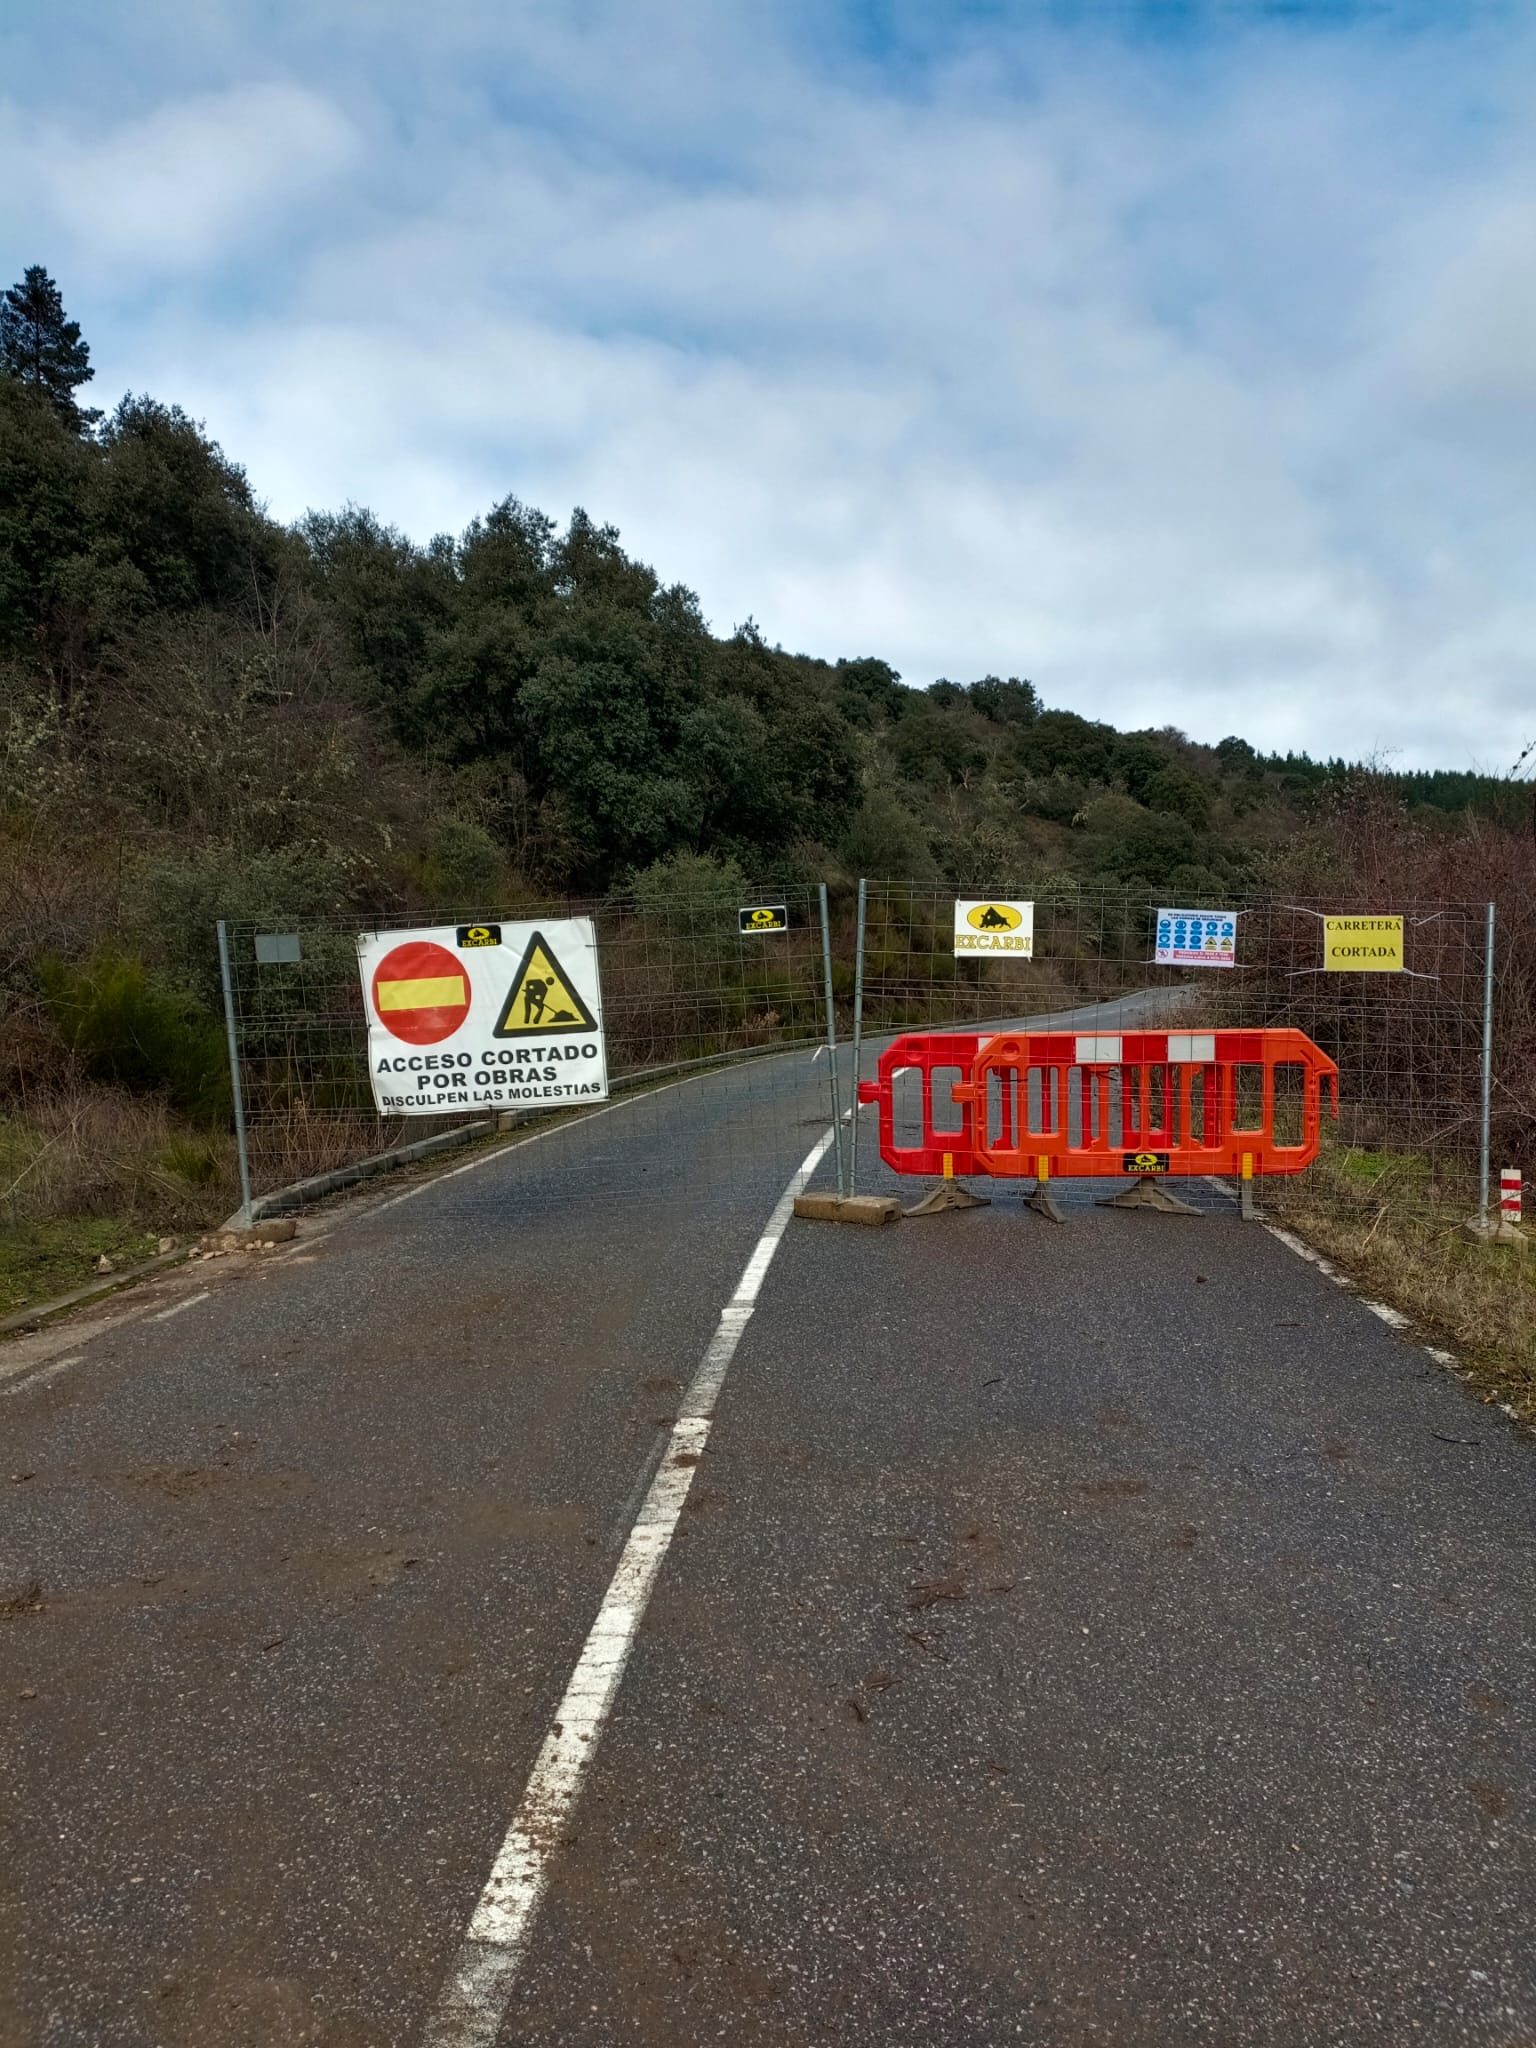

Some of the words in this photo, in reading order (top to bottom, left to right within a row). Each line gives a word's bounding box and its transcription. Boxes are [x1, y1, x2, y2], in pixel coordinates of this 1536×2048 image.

[1326, 920, 1401, 931] CARRETERA
[955, 934, 1031, 951] EXCARBI
[1331, 946, 1396, 957] CORTADA
[377, 1052, 472, 1073] ACCESO
[481, 1043, 598, 1066] CORTADO
[417, 1072, 467, 1090] POR
[474, 1066, 557, 1086] OBRAS
[381, 1091, 468, 1107] DISCULPEN
[473, 1088, 503, 1101] LAS
[508, 1082, 601, 1099] MOLESTIAS
